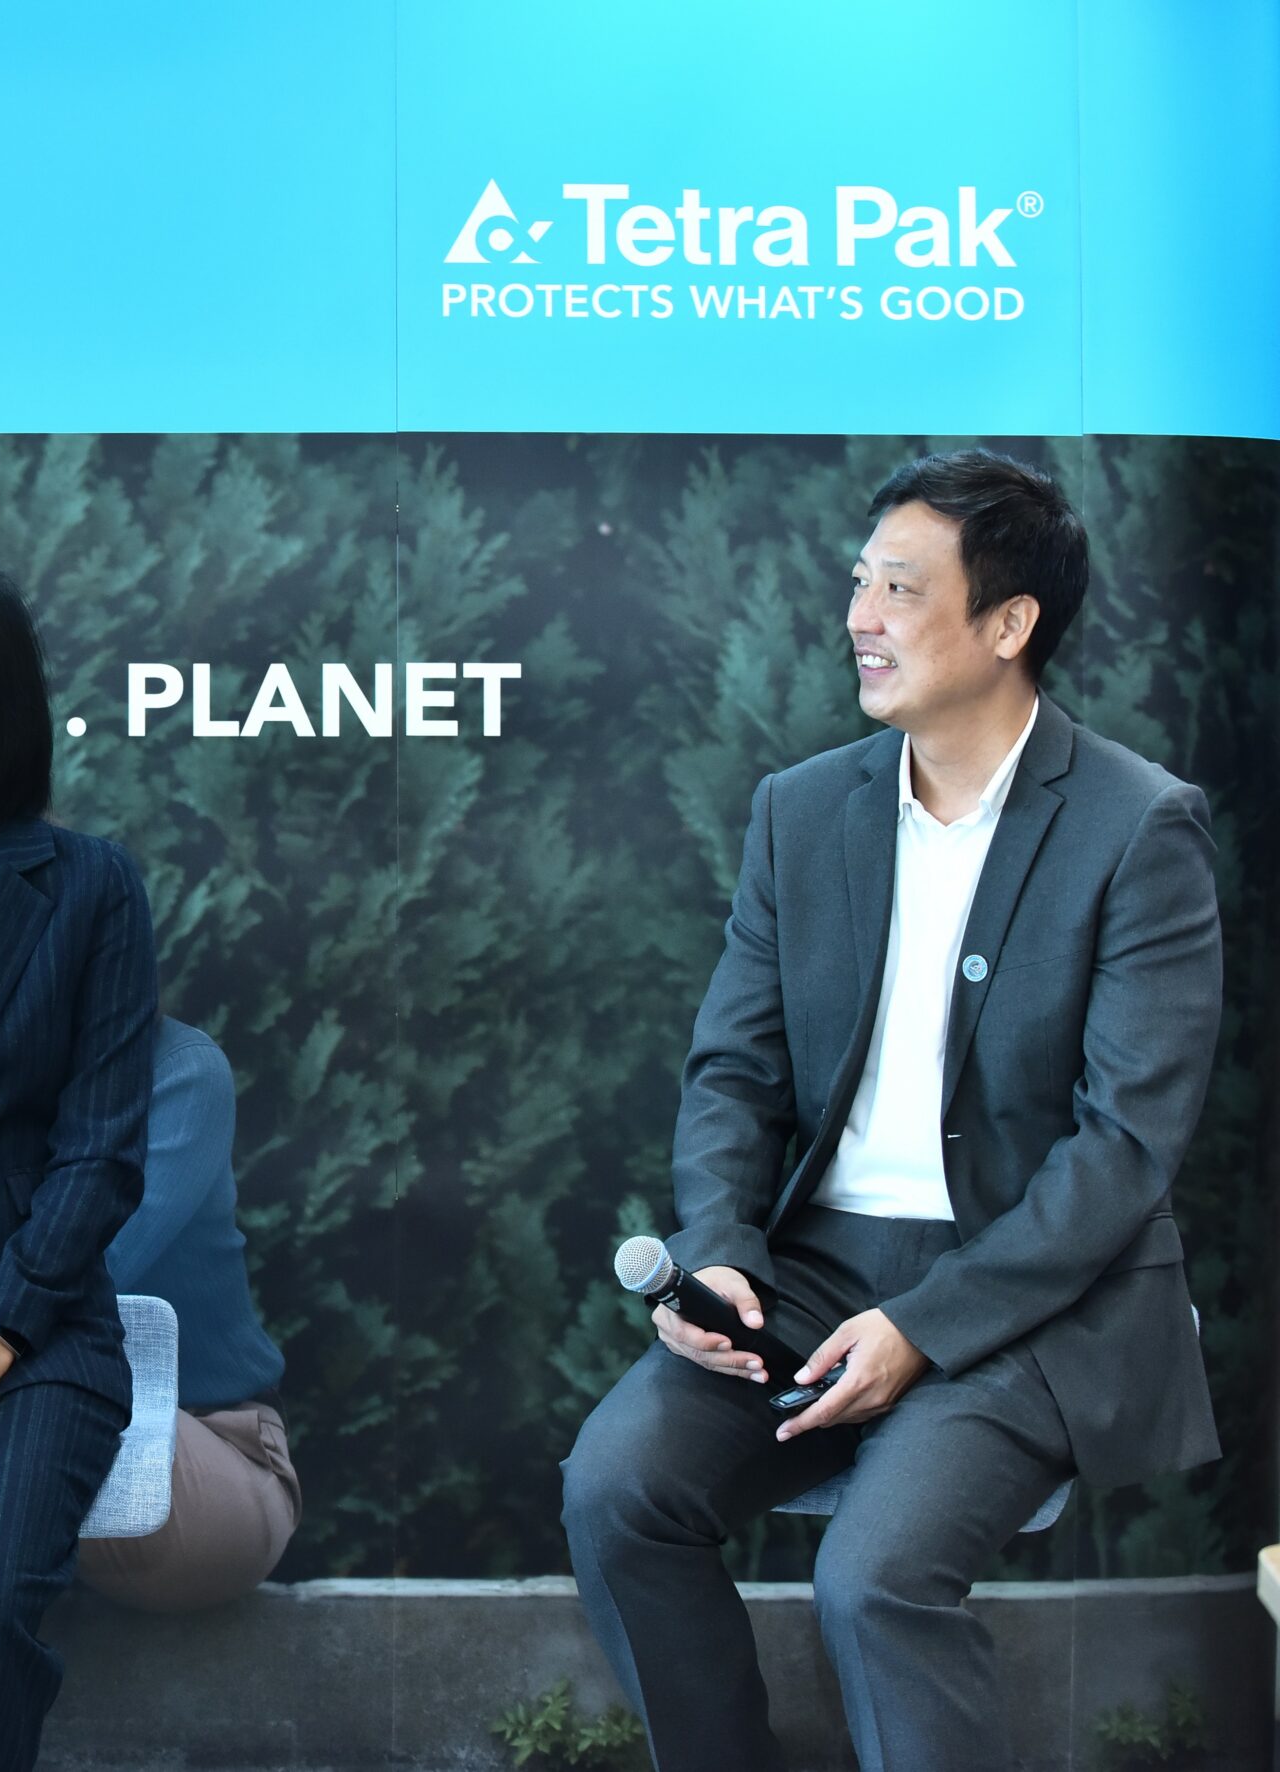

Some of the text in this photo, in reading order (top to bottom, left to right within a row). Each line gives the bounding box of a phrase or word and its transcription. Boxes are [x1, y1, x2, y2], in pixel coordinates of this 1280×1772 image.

[562, 183, 809, 267] Tetra
[442, 283, 1025, 321] PROTECTS WHAT'S GOOD
[128, 662, 522, 737] PLANET
